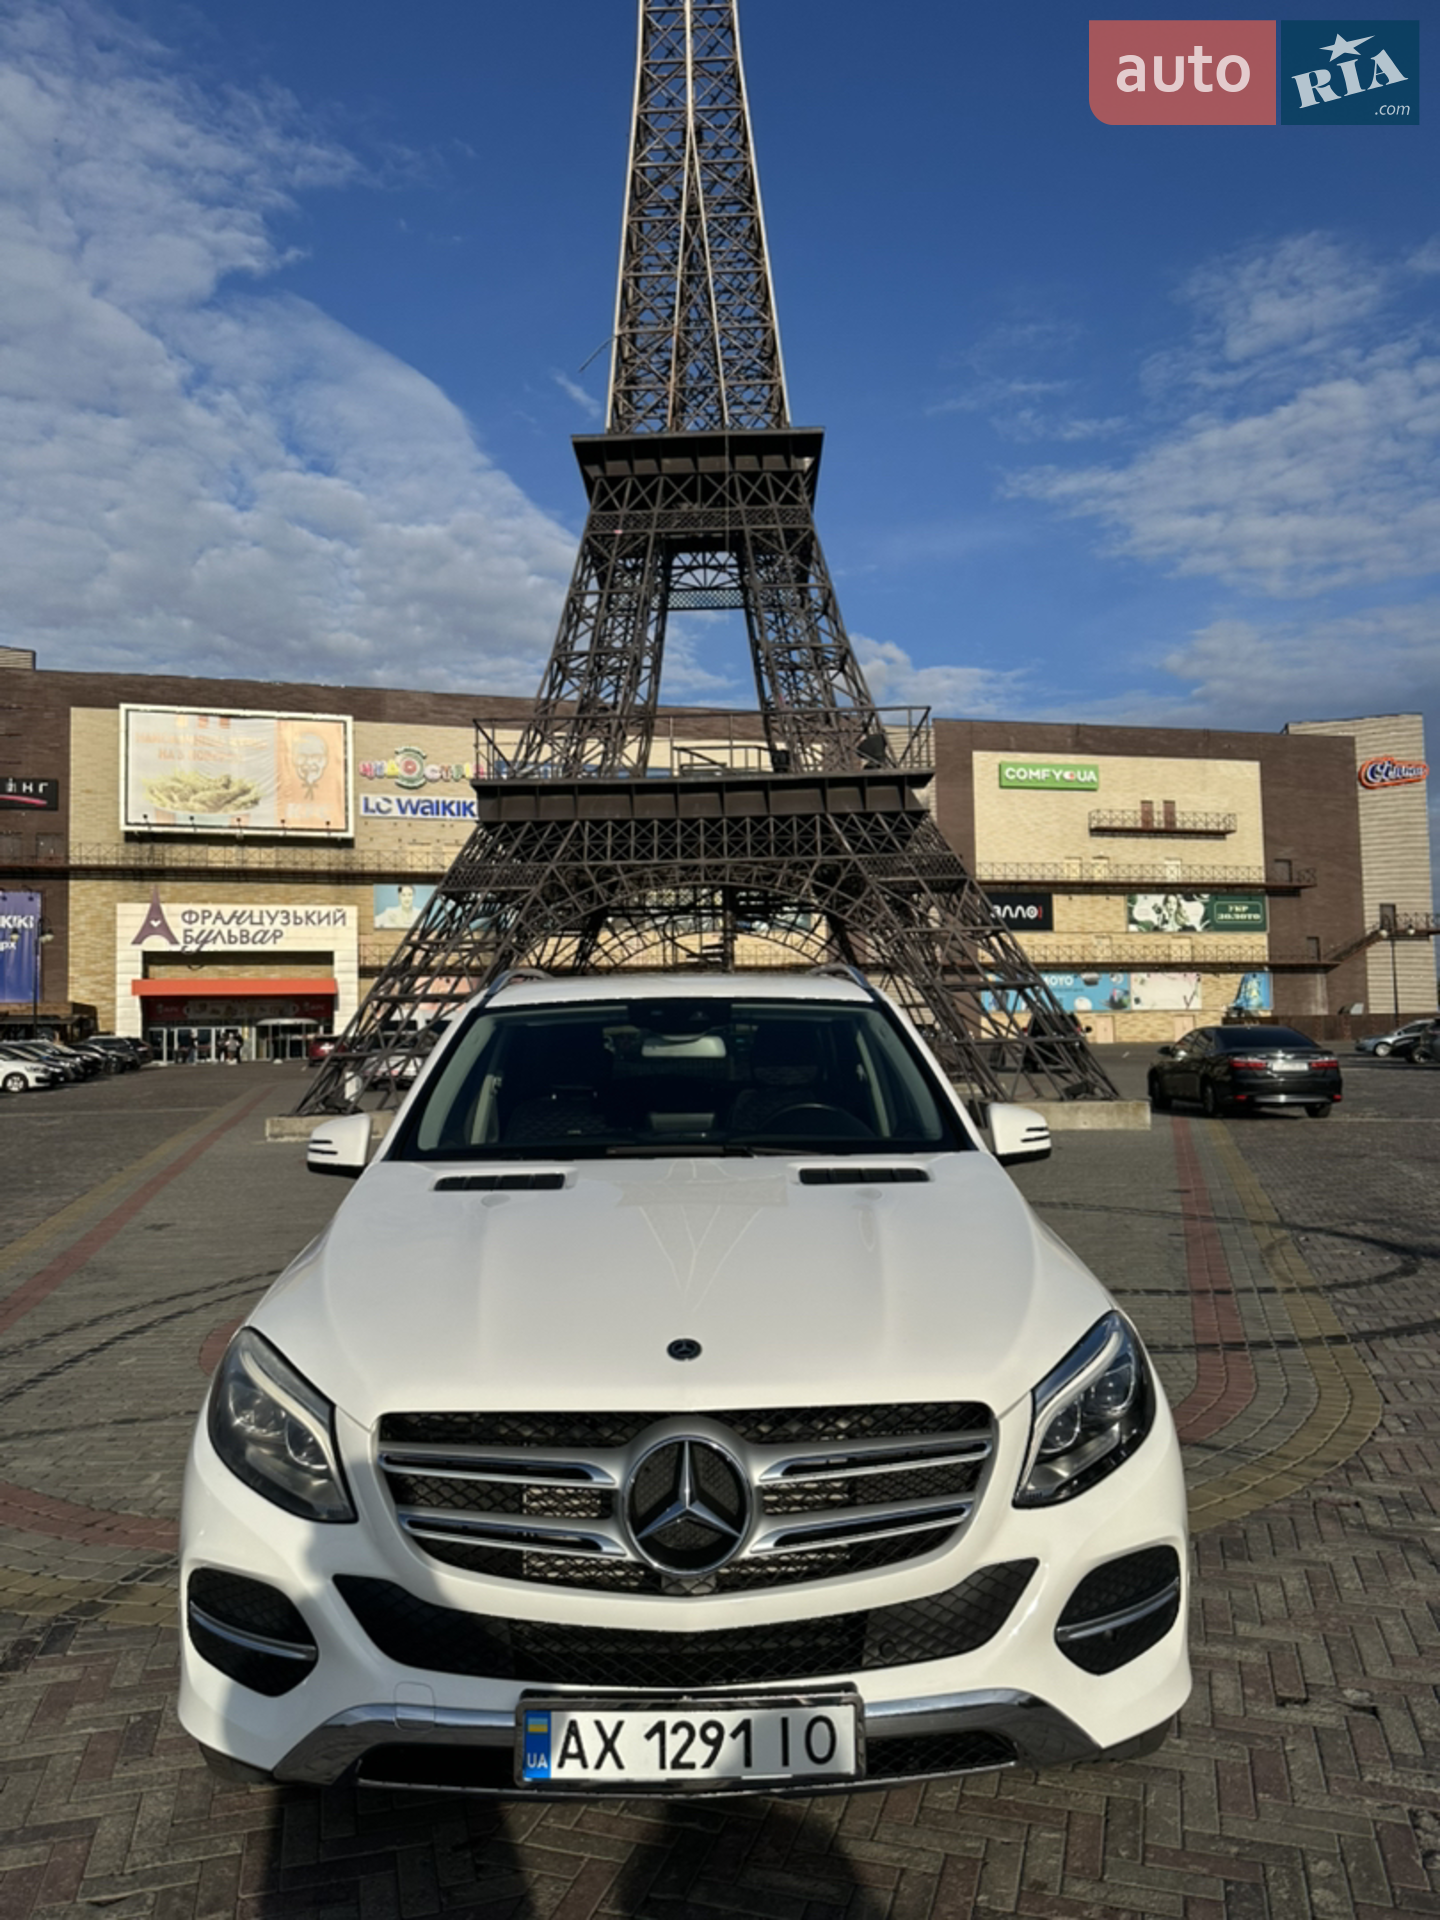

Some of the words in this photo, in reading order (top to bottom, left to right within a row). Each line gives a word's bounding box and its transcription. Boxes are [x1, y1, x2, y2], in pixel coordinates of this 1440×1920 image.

[1005, 767, 1063, 781] COMFY
[362, 796, 393, 814] LC
[395, 798, 477, 818] Waikik
[181, 908, 347, 926] ФРАНЦУЗЬКИЙ
[557, 1718, 625, 1770] AX
[643, 1717, 753, 1770] 1291
[780, 1714, 837, 1768] IO
[526, 1753, 548, 1769] UA
